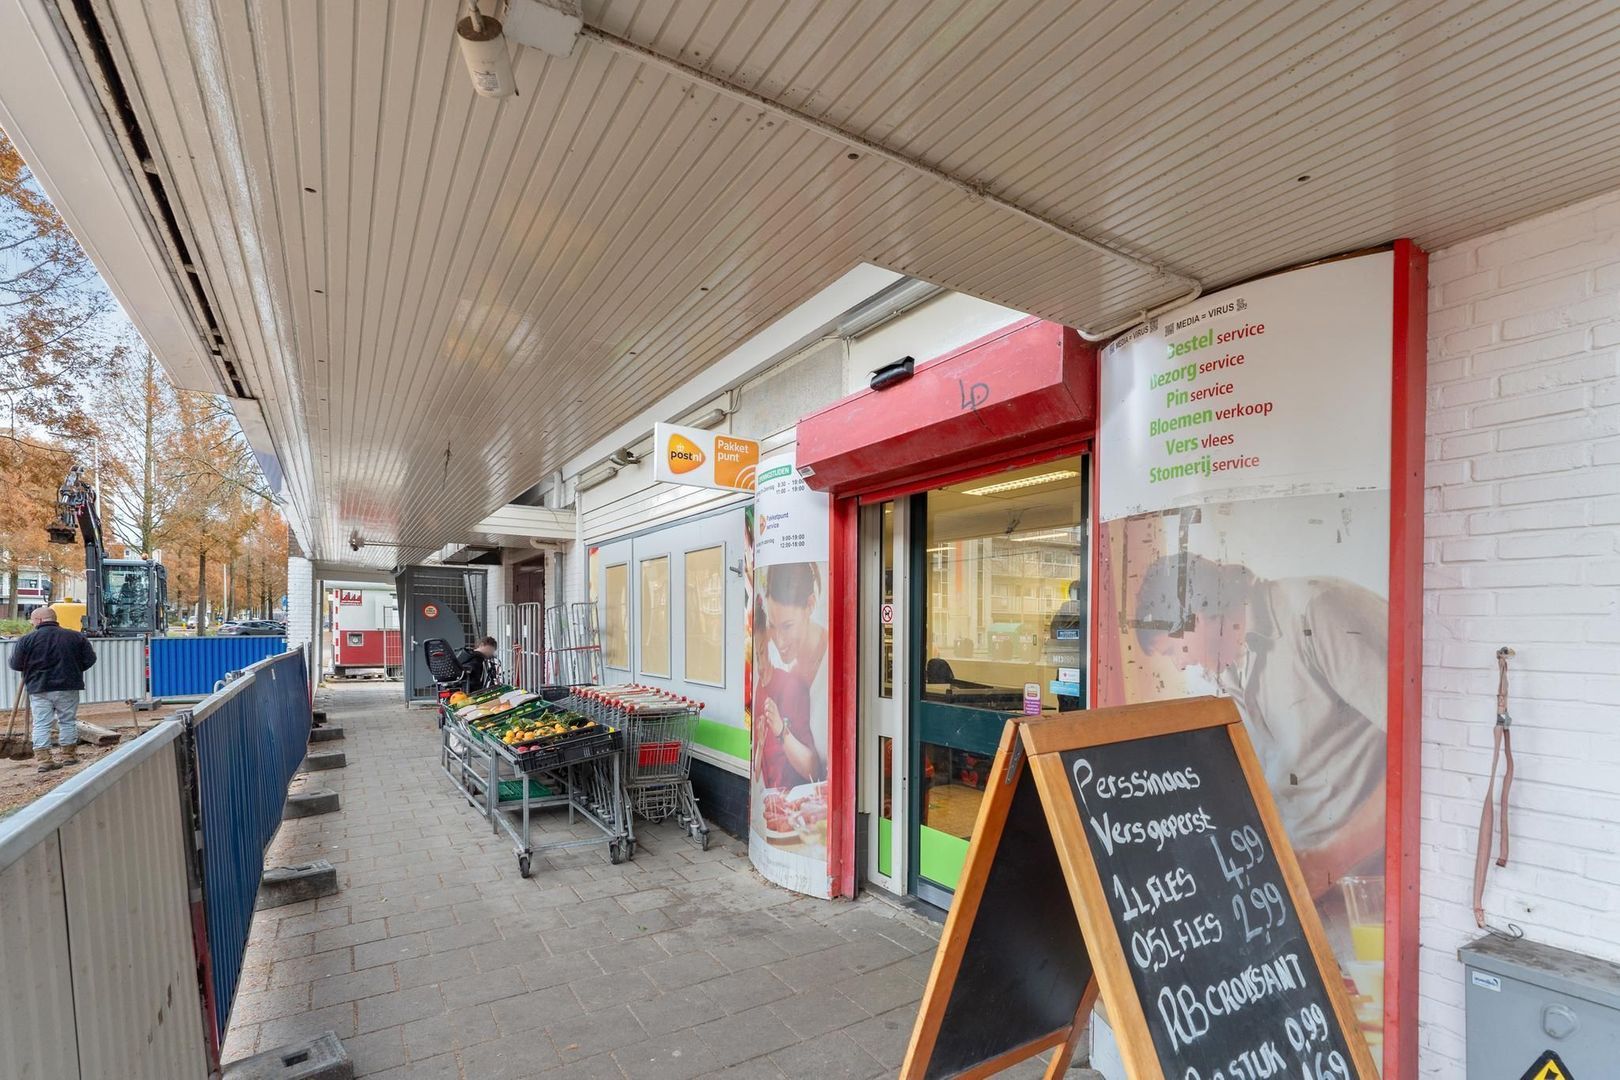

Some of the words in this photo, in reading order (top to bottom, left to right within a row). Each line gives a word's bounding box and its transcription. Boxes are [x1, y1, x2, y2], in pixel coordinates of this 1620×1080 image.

[1176, 314, 1200, 330] MEDIA
[1208, 303, 1235, 318] VIRUS
[1216, 322, 1265, 344] service
[1199, 353, 1245, 374] service
[1166, 389, 1189, 408] Pin
[1190, 382, 1234, 401] service
[1149, 408, 1213, 437] Bloemen
[1215, 401, 1273, 420] verkoop
[717, 440, 749, 454] Pakket
[1166, 437, 1198, 455] Vers
[1201, 434, 1234, 448] vlees
[717, 452, 740, 462] punt
